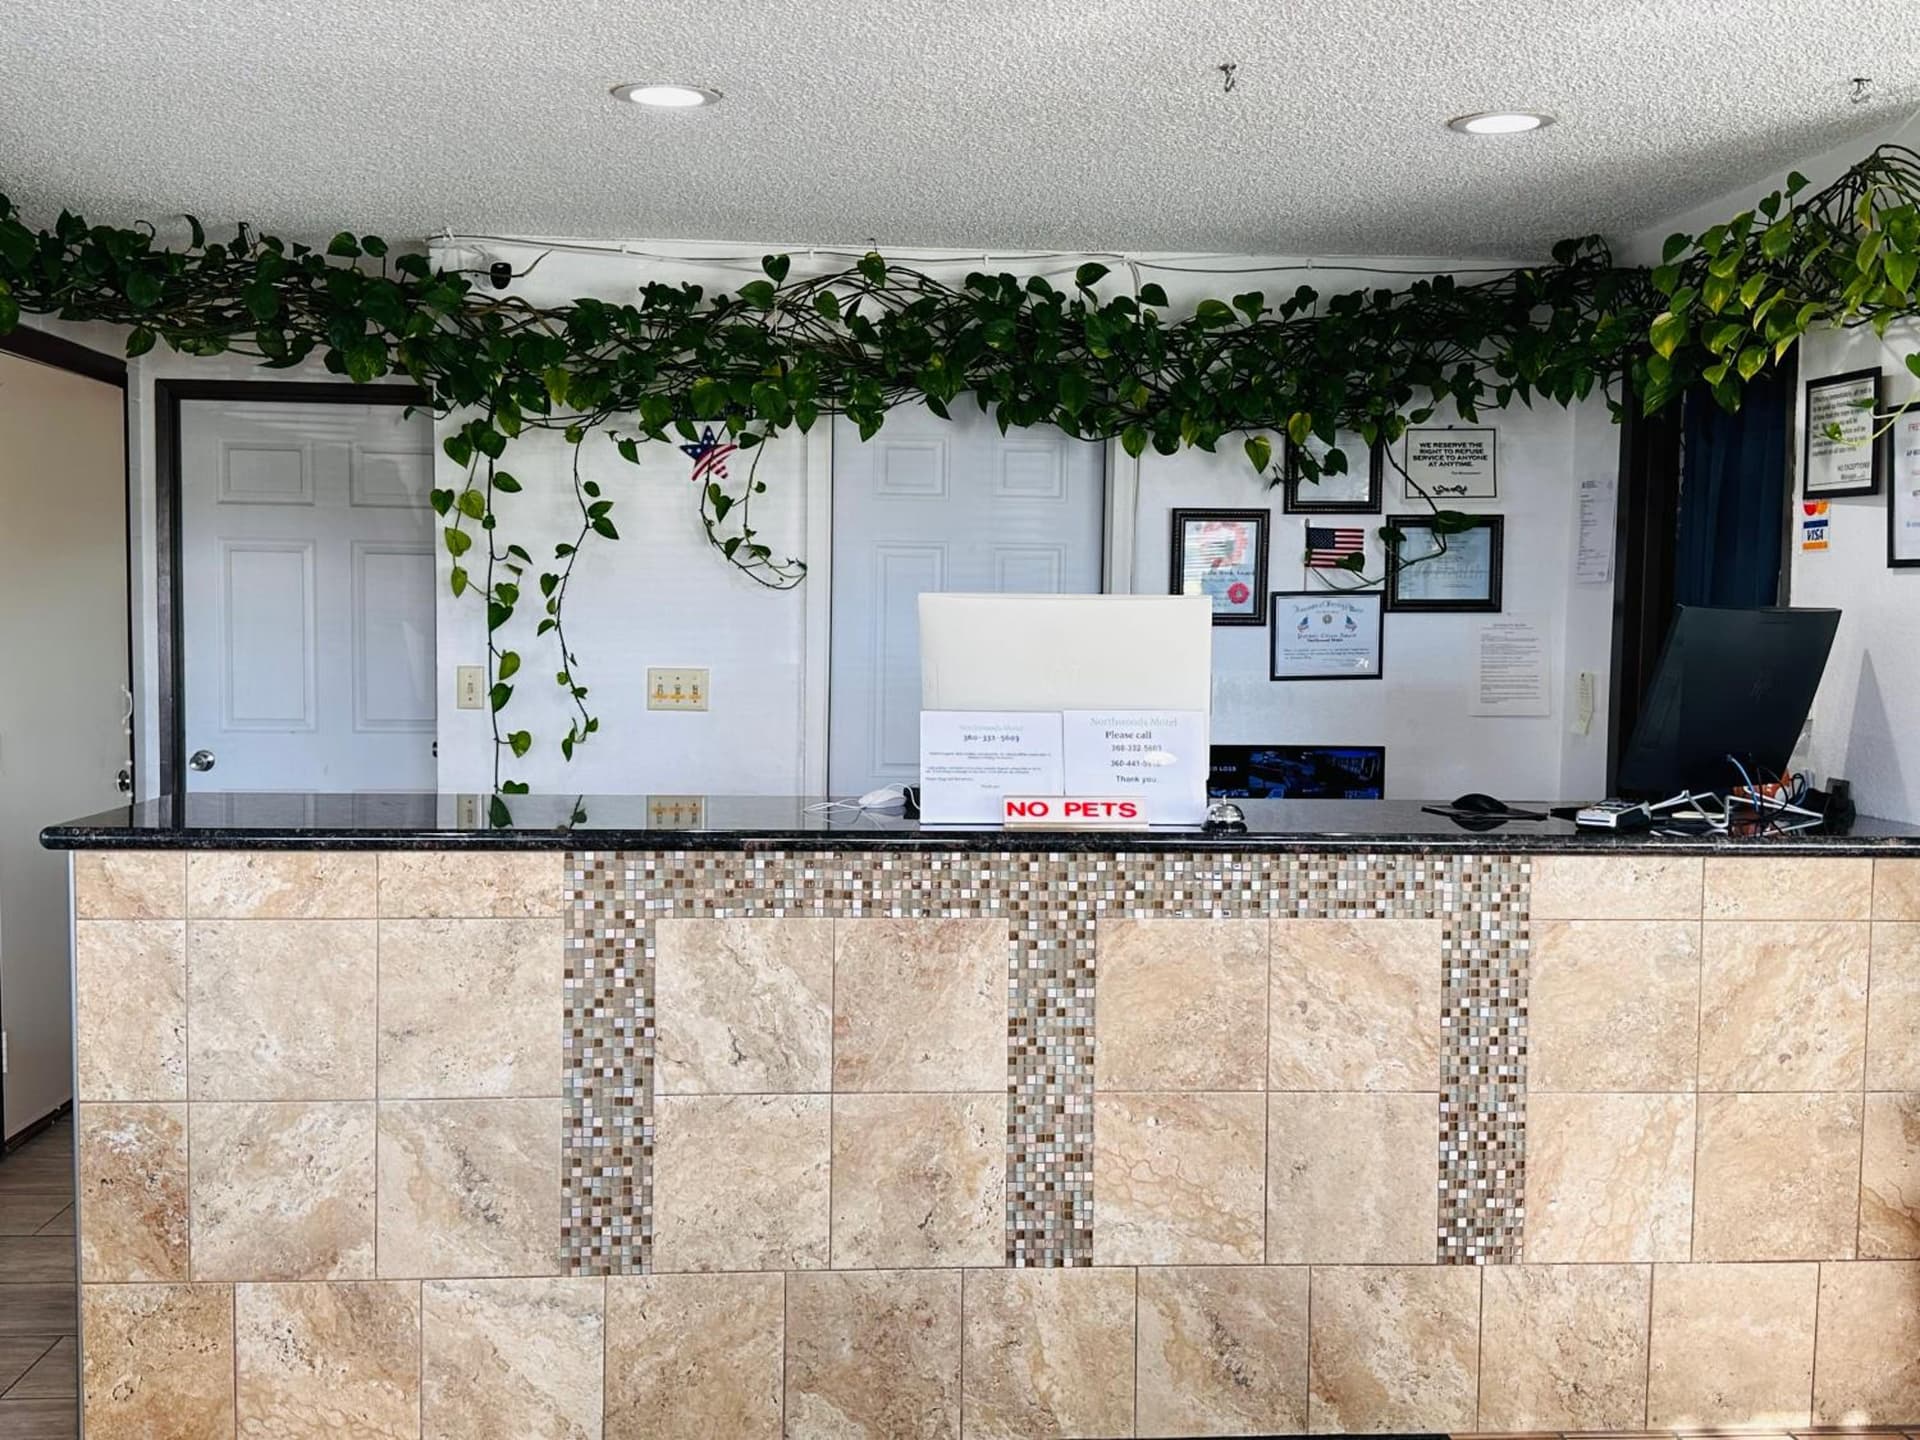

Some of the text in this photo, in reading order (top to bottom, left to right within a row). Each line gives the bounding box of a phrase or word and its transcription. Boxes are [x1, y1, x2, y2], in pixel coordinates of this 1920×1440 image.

[1807, 528, 1824, 541] VISA
[1150, 716, 1178, 727] Motel
[1105, 730, 1152, 740] Please call
[1116, 775, 1157, 785] Thank you
[1006, 801, 1138, 818] NO PETS
